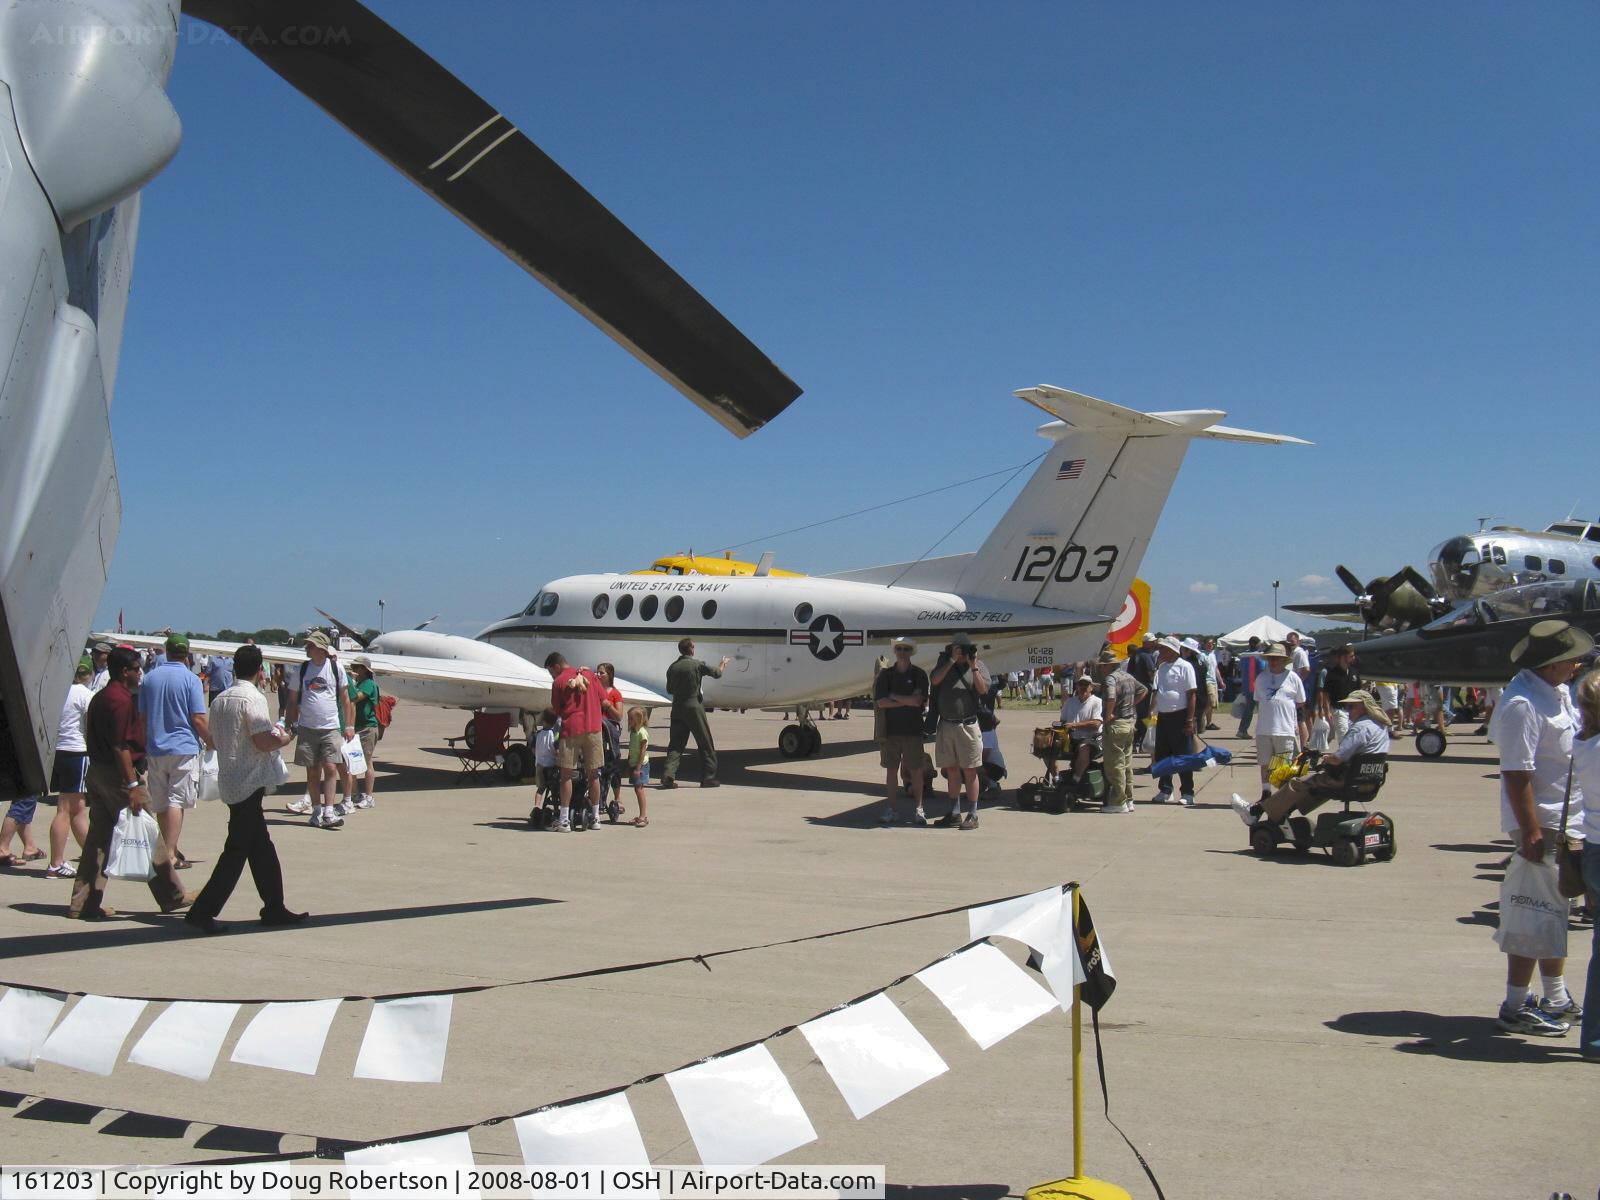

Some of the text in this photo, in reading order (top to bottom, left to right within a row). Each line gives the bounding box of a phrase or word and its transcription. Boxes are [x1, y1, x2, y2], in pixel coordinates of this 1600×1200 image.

[1011, 545, 1119, 582] 1203
[609, 581, 730, 592] UNITED STATES NAVY
[917, 610, 1014, 623] CHAMBERS FIELD
[1028, 655, 1053, 664] 161203
